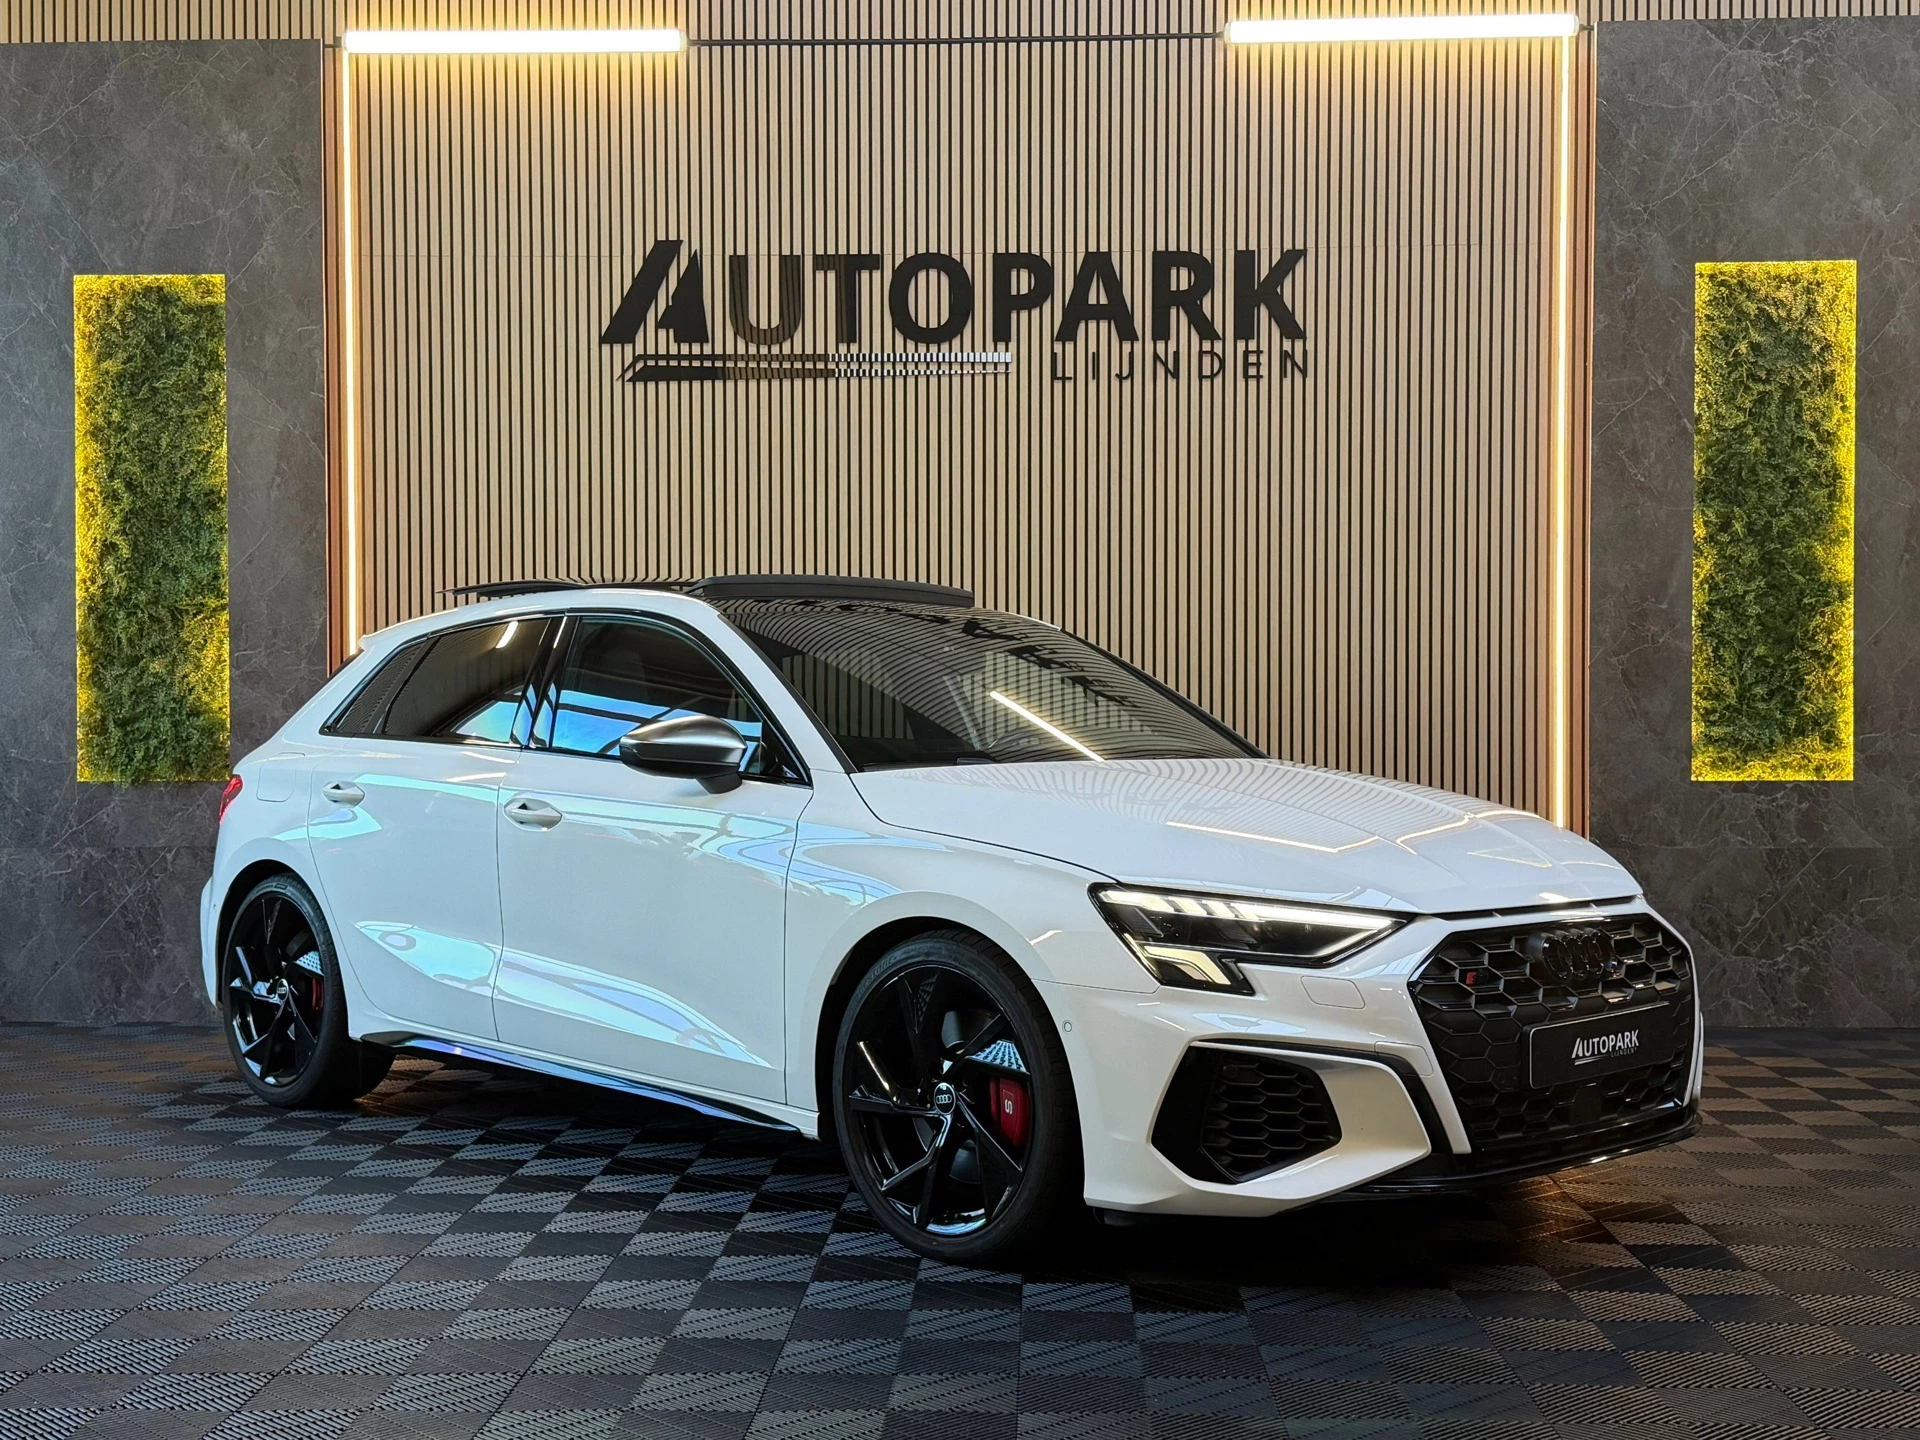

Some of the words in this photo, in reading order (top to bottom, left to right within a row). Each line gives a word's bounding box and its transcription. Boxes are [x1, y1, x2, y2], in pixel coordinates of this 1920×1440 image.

[600, 239, 1307, 345] AUTOPARK
[1054, 348, 1307, 381] LIJNDEN
[1571, 1029, 1639, 1058] AUTOPARK
